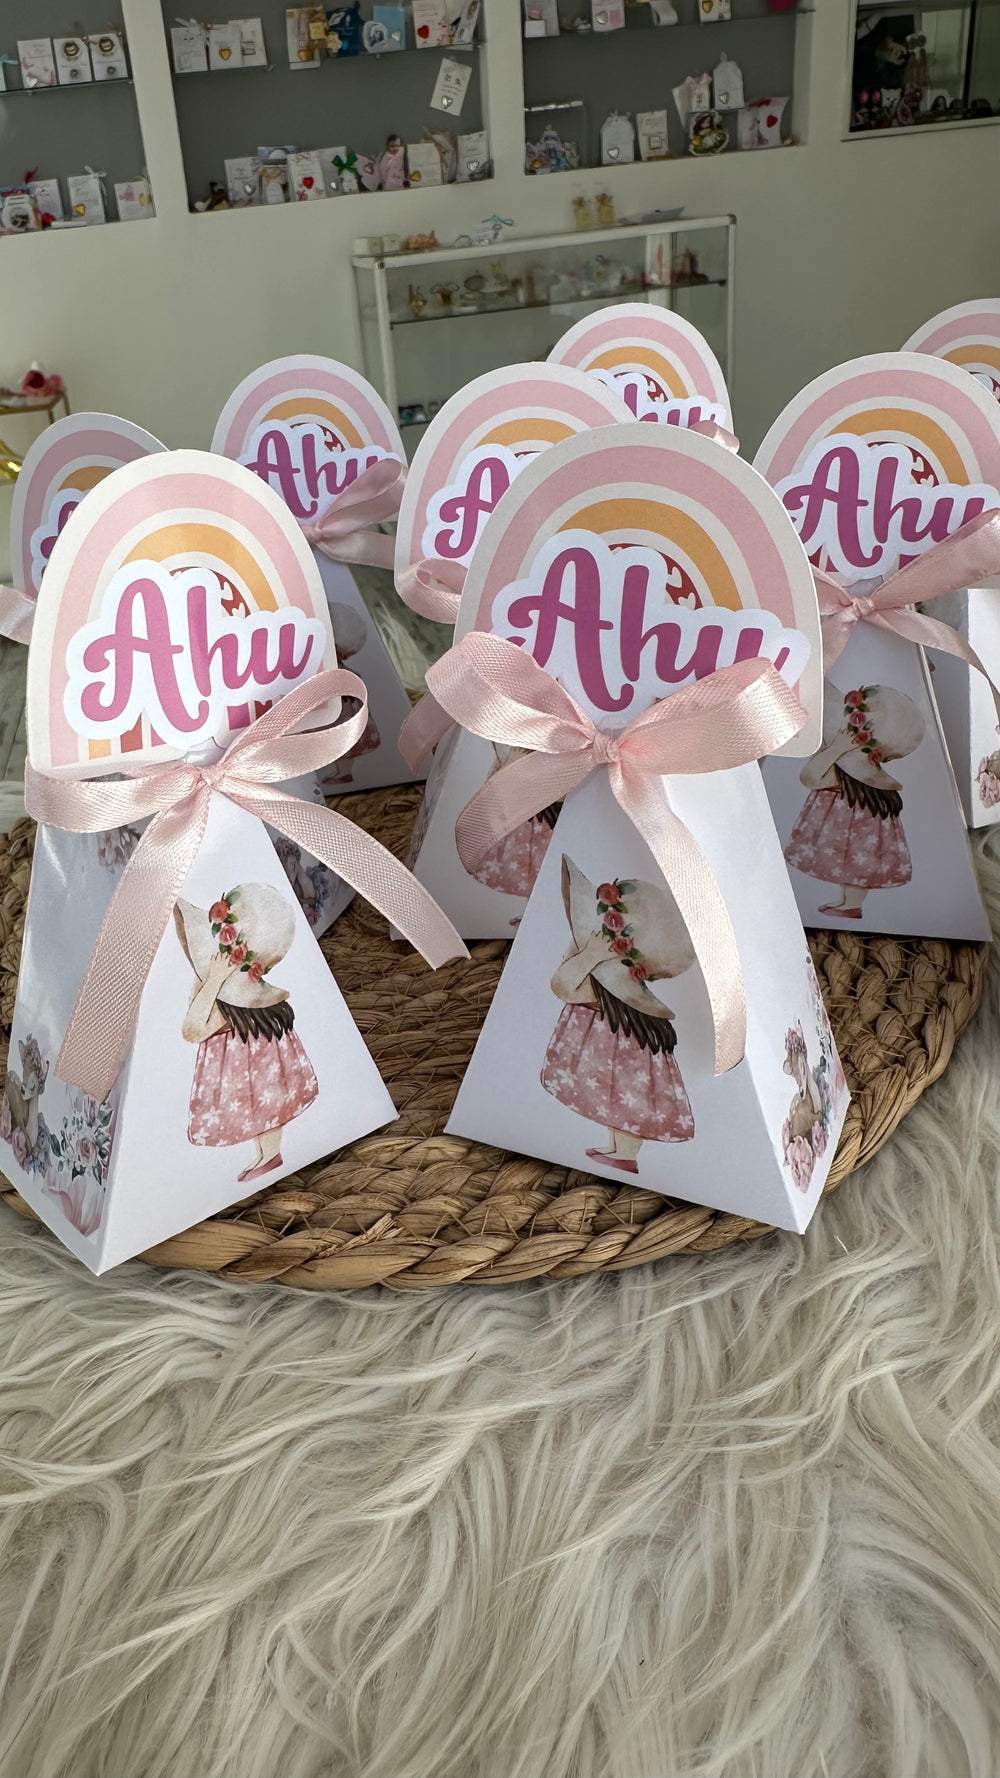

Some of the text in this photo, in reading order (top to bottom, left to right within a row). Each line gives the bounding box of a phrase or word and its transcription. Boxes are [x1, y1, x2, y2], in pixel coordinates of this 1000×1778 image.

[782, 446, 985, 567] Ahu
[81, 578, 314, 733] Ahu
[506, 547, 790, 712] Ahu
